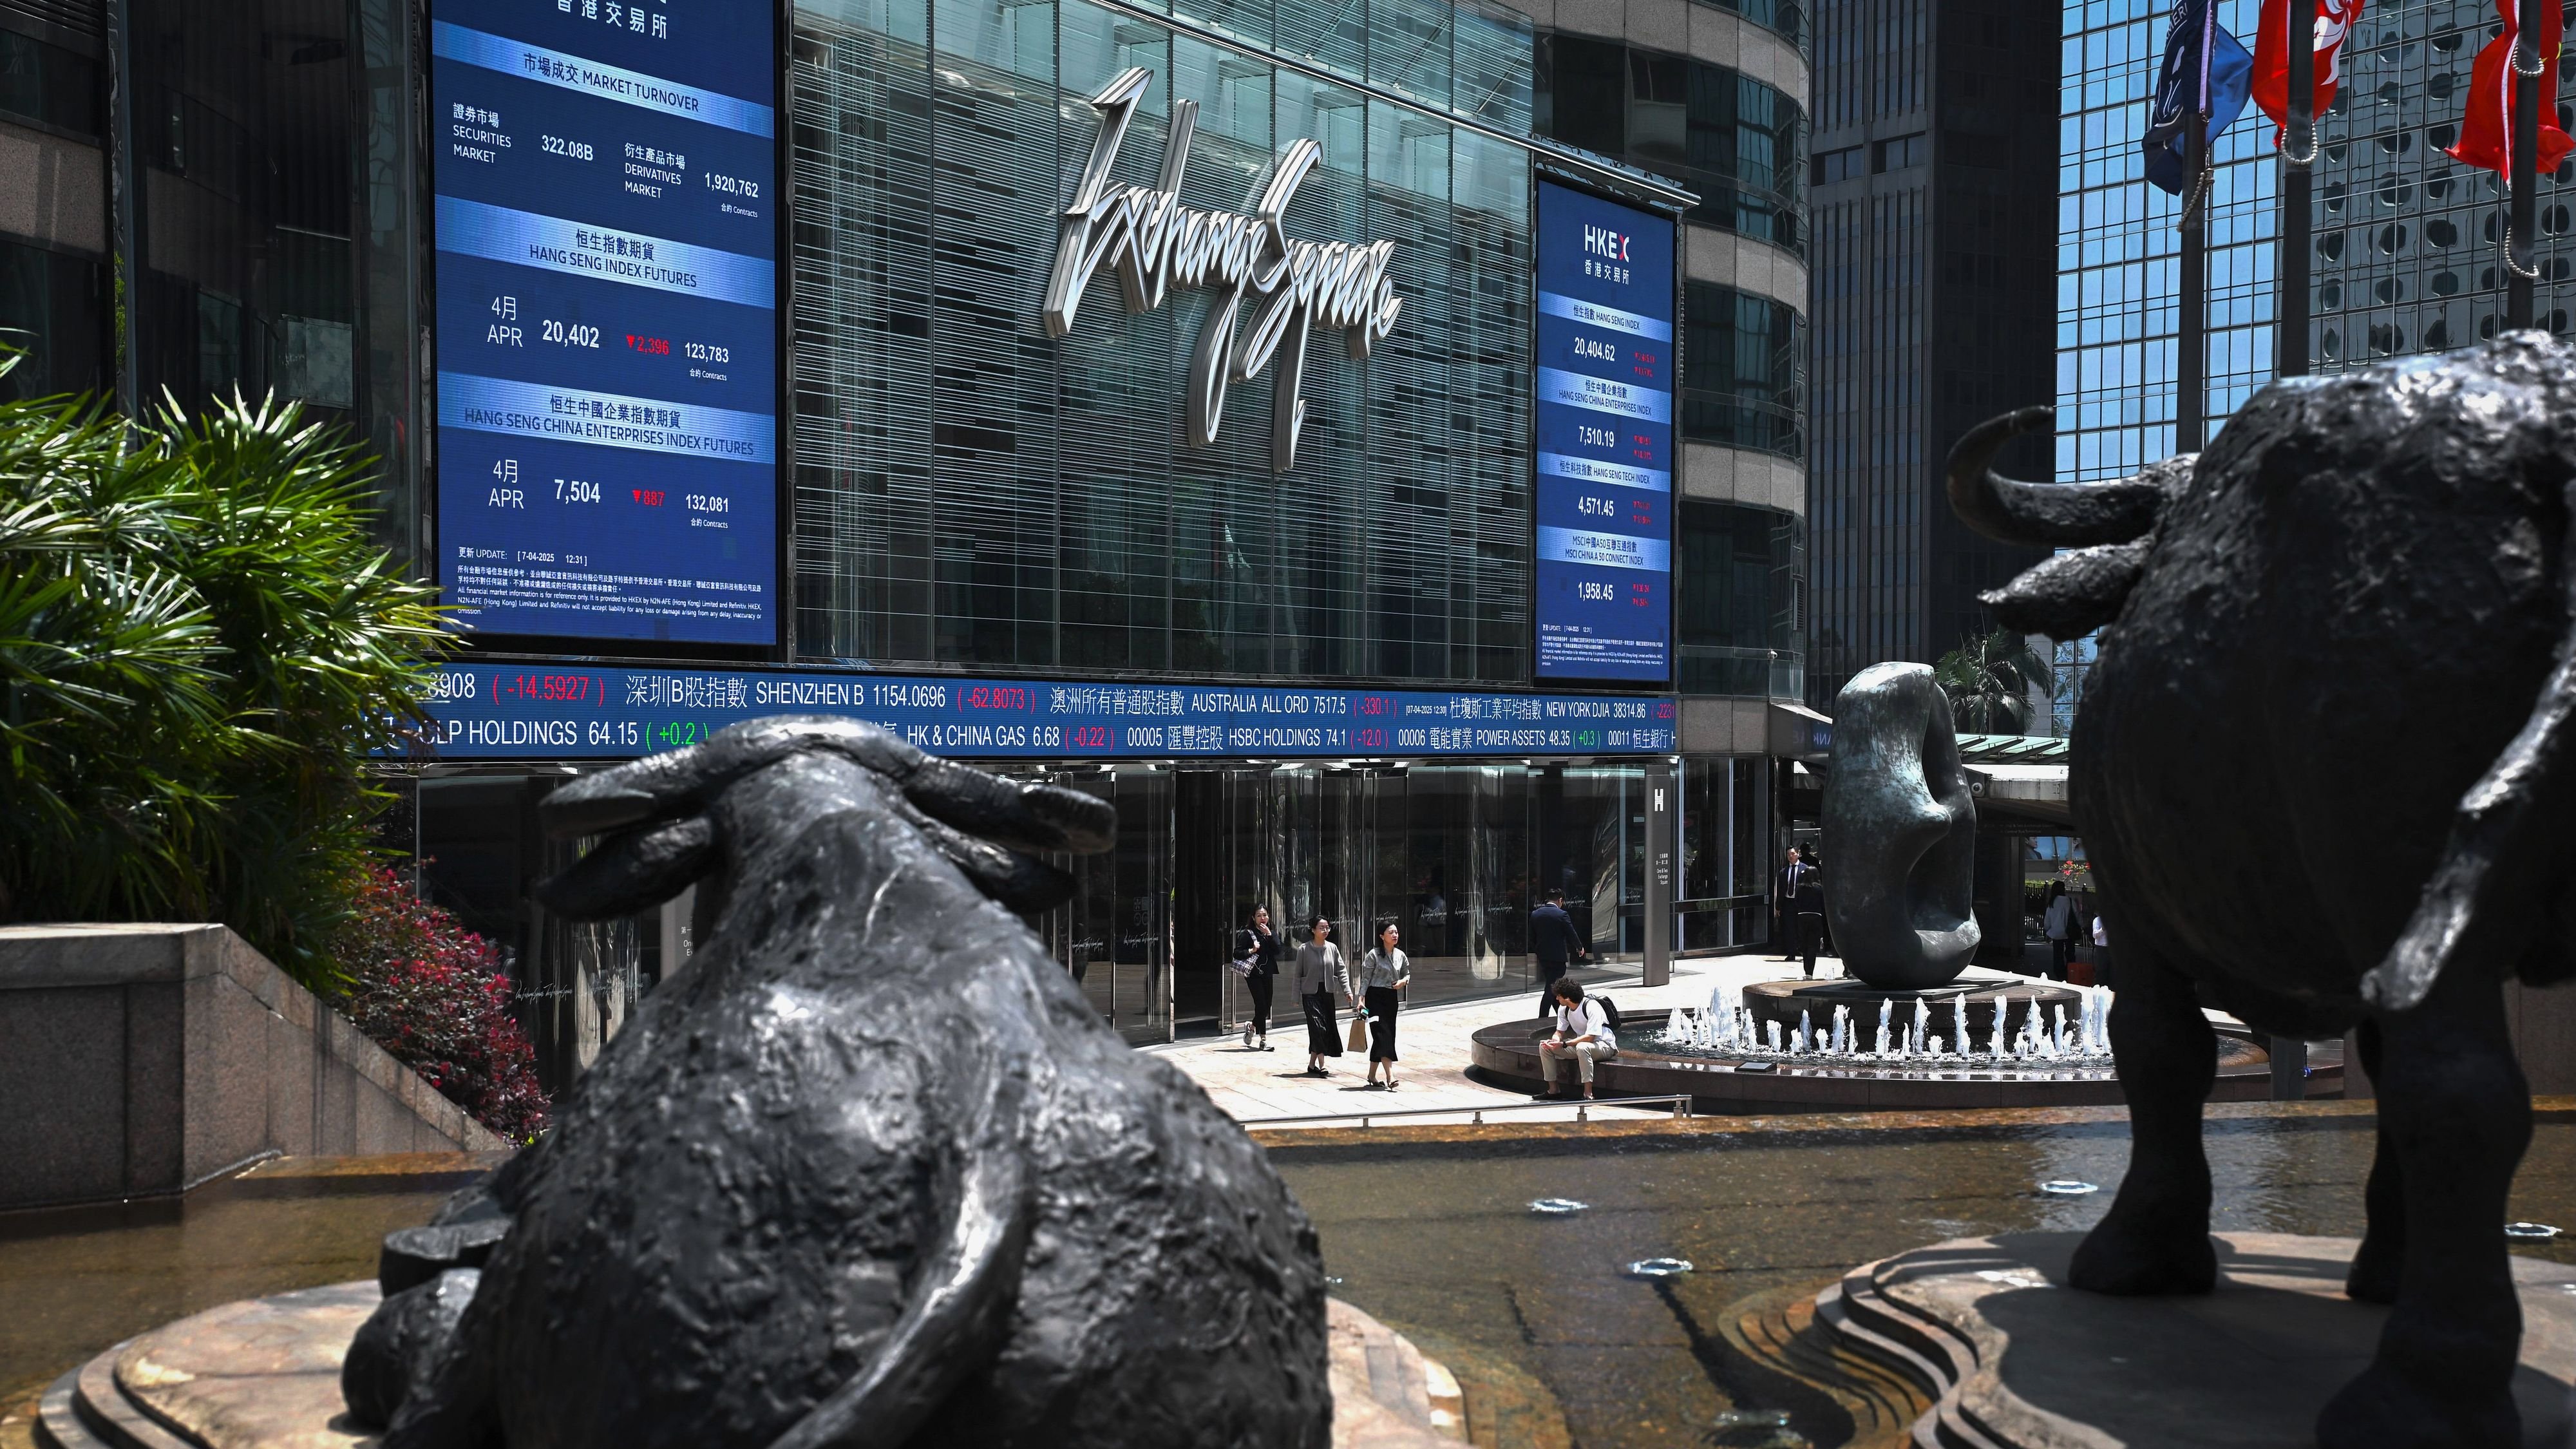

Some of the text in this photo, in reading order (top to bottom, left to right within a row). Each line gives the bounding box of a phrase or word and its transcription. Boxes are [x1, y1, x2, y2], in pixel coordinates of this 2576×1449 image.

[524, 53, 699, 112] 市場成交 MARKET TURNOVER
[453, 125, 511, 147] SECURITIES
[454, 144, 495, 164] MARKET
[542, 135, 593, 161] 322.08B
[625, 142, 685, 170] 衍生產品市場
[625, 162, 681, 185] DERIVATIVES
[705, 172, 759, 198] 1,920,762
[625, 181, 662, 198] MARKET
[733, 206, 758, 218] Contracts
[576, 229, 654, 262] 恒生指數期貨
[530, 245, 697, 287] HANG SENG INDEX FUTURES
[1585, 259, 1629, 285] 香港交易所
[491, 296, 516, 321] 4月
[1596, 312, 1611, 323] HANG
[1611, 316, 1624, 326] SENG
[1625, 319, 1640, 330] INDEX
[487, 325, 523, 347] APR
[542, 320, 729, 363] 20,402 2,396 123,783
[1575, 337, 1615, 361] 20,404.62
[702, 370, 727, 381] Contracts
[550, 394, 681, 429] 恒生中國企業指數期貨
[1559, 389, 1652, 416] HANG SENG CHINA ENTERPRISES INDEX
[465, 408, 754, 456] HANG SENG CHINA ENTERPRISES INDEX FUTURES
[1579, 426, 1615, 448] 7,510.19
[493, 459, 518, 483] 4月
[1593, 467, 1608, 478] HANG
[1609, 469, 1622, 480] SENG
[1622, 471, 1634, 482] TECH
[1635, 473, 1650, 484] INDEX
[489, 488, 524, 509] APR
[554, 479, 729, 513] 7,504 887 132,081
[1578, 496, 1614, 516] 4,571.45
[703, 519, 728, 529] Contracts
[459, 547, 474, 558] 更新
[475, 549, 507, 560] UPDATE:
[1565, 548, 1577, 558] MSCI
[1578, 550, 1594, 560] CHINA
[1605, 553, 1629, 564] CONNECT
[1629, 556, 1644, 565] INDEX
[509, 589, 538, 597] information
[553, 591, 576, 600] reference
[600, 594, 621, 603] provided
[702, 600, 718, 608] Limited
[1578, 582, 1613, 601] 1,958.45
[662, 607, 680, 616] damage
[682, 609, 697, 618] arising
[733, 612, 755, 620] inaccuracy
[757, 681, 849, 705] SHENZHEN
[855, 685, 864, 705] B
[873, 685, 945, 708] 1154.0696
[1050, 687, 1184, 715] 澳洲所有普通股指數
[1191, 694, 1257, 712] AUSTRALIA
[1262, 695, 1282, 713] ALL
[1284, 696, 1309, 714] ORD
[1314, 696, 1346, 714] 7517.5
[1450, 697, 1542, 720] 杜瓊斯工業平均指數
[1546, 702, 1566, 717] NEW
[1567, 702, 1591, 717] YORK
[1592, 703, 1610, 718] DJIA
[1613, 703, 1646, 719] 38314.86
[469, 720, 577, 745] HOLDINGS
[589, 721, 638, 746] 64.15
[907, 724, 929, 745] HK
[933, 725, 943, 746] &
[946, 725, 992, 746] CHINA
[996, 726, 1025, 746] GAS
[1033, 726, 1060, 746] 6.68
[1128, 727, 1162, 747] 00005
[1168, 725, 1223, 751] 匯豐控股
[1229, 728, 1261, 747] HSBC
[1264, 728, 1320, 747] HOLDINGS
[1326, 729, 1346, 746] 74.1
[1398, 730, 1426, 746] 00006
[1429, 727, 1472, 750] 電能實業
[1477, 730, 1510, 746] POWER
[1511, 730, 1546, 746] ASSETS
[1549, 731, 1570, 746] 48.35
[1608, 731, 1630, 746] 00011
[1633, 728, 1668, 749] 恒生銀行
